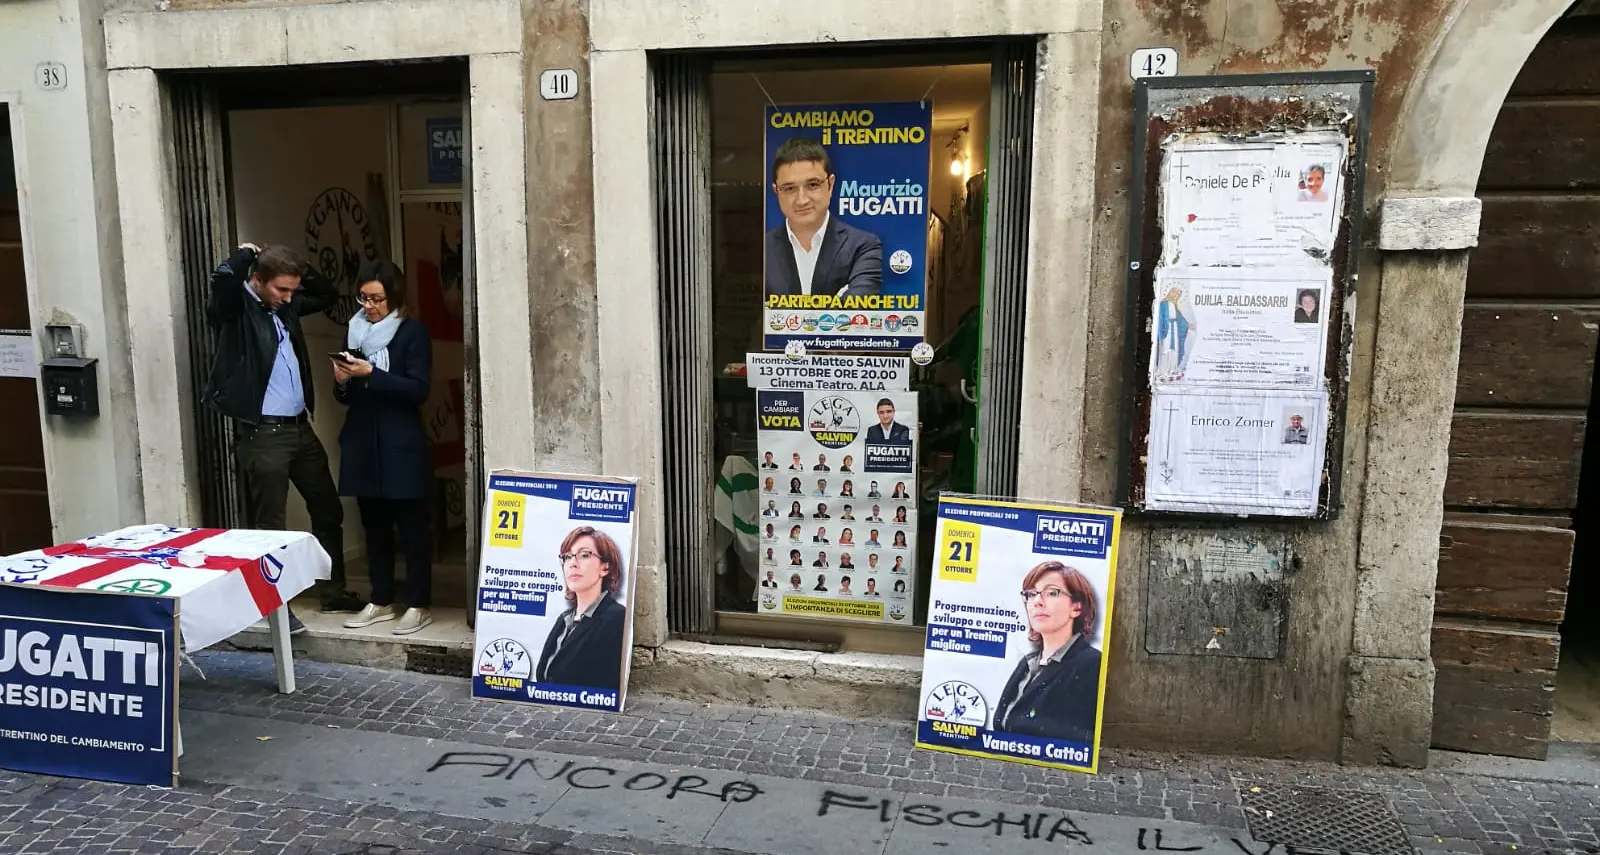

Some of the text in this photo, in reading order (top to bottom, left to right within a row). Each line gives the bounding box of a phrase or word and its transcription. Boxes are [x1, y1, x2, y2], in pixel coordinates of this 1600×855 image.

[1142, 53, 1166, 76] 42
[43, 68, 60, 87] 38
[549, 74, 569, 94] 40
[770, 109, 874, 129] CAMBIAMO
[822, 126, 925, 146] il TRENTINO
[840, 178, 923, 197] Maurizio
[1232, 175, 1249, 189] De
[839, 197, 923, 216] FUGATTI
[305, 192, 378, 262] LEGA NORD
[769, 294, 920, 309] PARTECIPA ANCHE TU!
[1194, 294, 1288, 308] DUILIA BALDASSARRI
[752, 356, 791, 365] Incontro
[811, 356, 854, 367] Matteo
[856, 357, 905, 369] SALVINI
[759, 367, 897, 380] 13 OTTOBRE ORE 20.00
[770, 377, 814, 389] Cinema
[859, 381, 886, 391] ALA
[813, 398, 853, 416] LEGA
[761, 415, 801, 428] VOTA
[1191, 415, 1275, 428] Enrico Zomer
[815, 432, 853, 442] SALVINI
[867, 446, 910, 456] FUGATTI
[573, 487, 629, 503] FUGATTI
[576, 501, 624, 511] PRESIDENTE
[498, 510, 519, 530] 21
[969, 509, 1004, 519] PROVINCIALI
[948, 529, 975, 539] DOMENICA
[1038, 518, 1105, 537] FUGATTI
[494, 532, 519, 541] OTTOBRE
[1042, 533, 1099, 545] PRESIDENTE
[949, 541, 973, 562] 21
[485, 565, 558, 581] Programmazione,
[945, 565, 972, 574] OTTOBRE
[484, 578, 519, 589] sviluppo
[527, 581, 563, 592] coraggio
[483, 590, 498, 600] per
[511, 590, 545, 602] Trentino
[482, 601, 517, 612] migliore
[785, 604, 835, 613] L'IMPORTANZA
[844, 608, 881, 617] SCEGLIERE
[935, 600, 1020, 620] Programmazione,
[933, 614, 974, 627] sviluppo
[983, 618, 1026, 632] coraggio
[932, 628, 1004, 643] per un Trentino
[485, 641, 524, 661] LEGA
[931, 639, 971, 653] migliore
[485, 675, 523, 688] SALVINI
[0, 683, 143, 718] ESIDENTE
[527, 685, 616, 707] Vanessa Cattoi
[932, 683, 980, 707] LEGA
[932, 721, 977, 737] SALVINI
[939, 731, 970, 740] TRENTINO
[0, 729, 145, 752] TRENTINO DEL CAMBIAMENTO
[982, 734, 1090, 763] Vanessa Cattoi
[427, 752, 1204, 851] ANCORA FISCHIA IL
